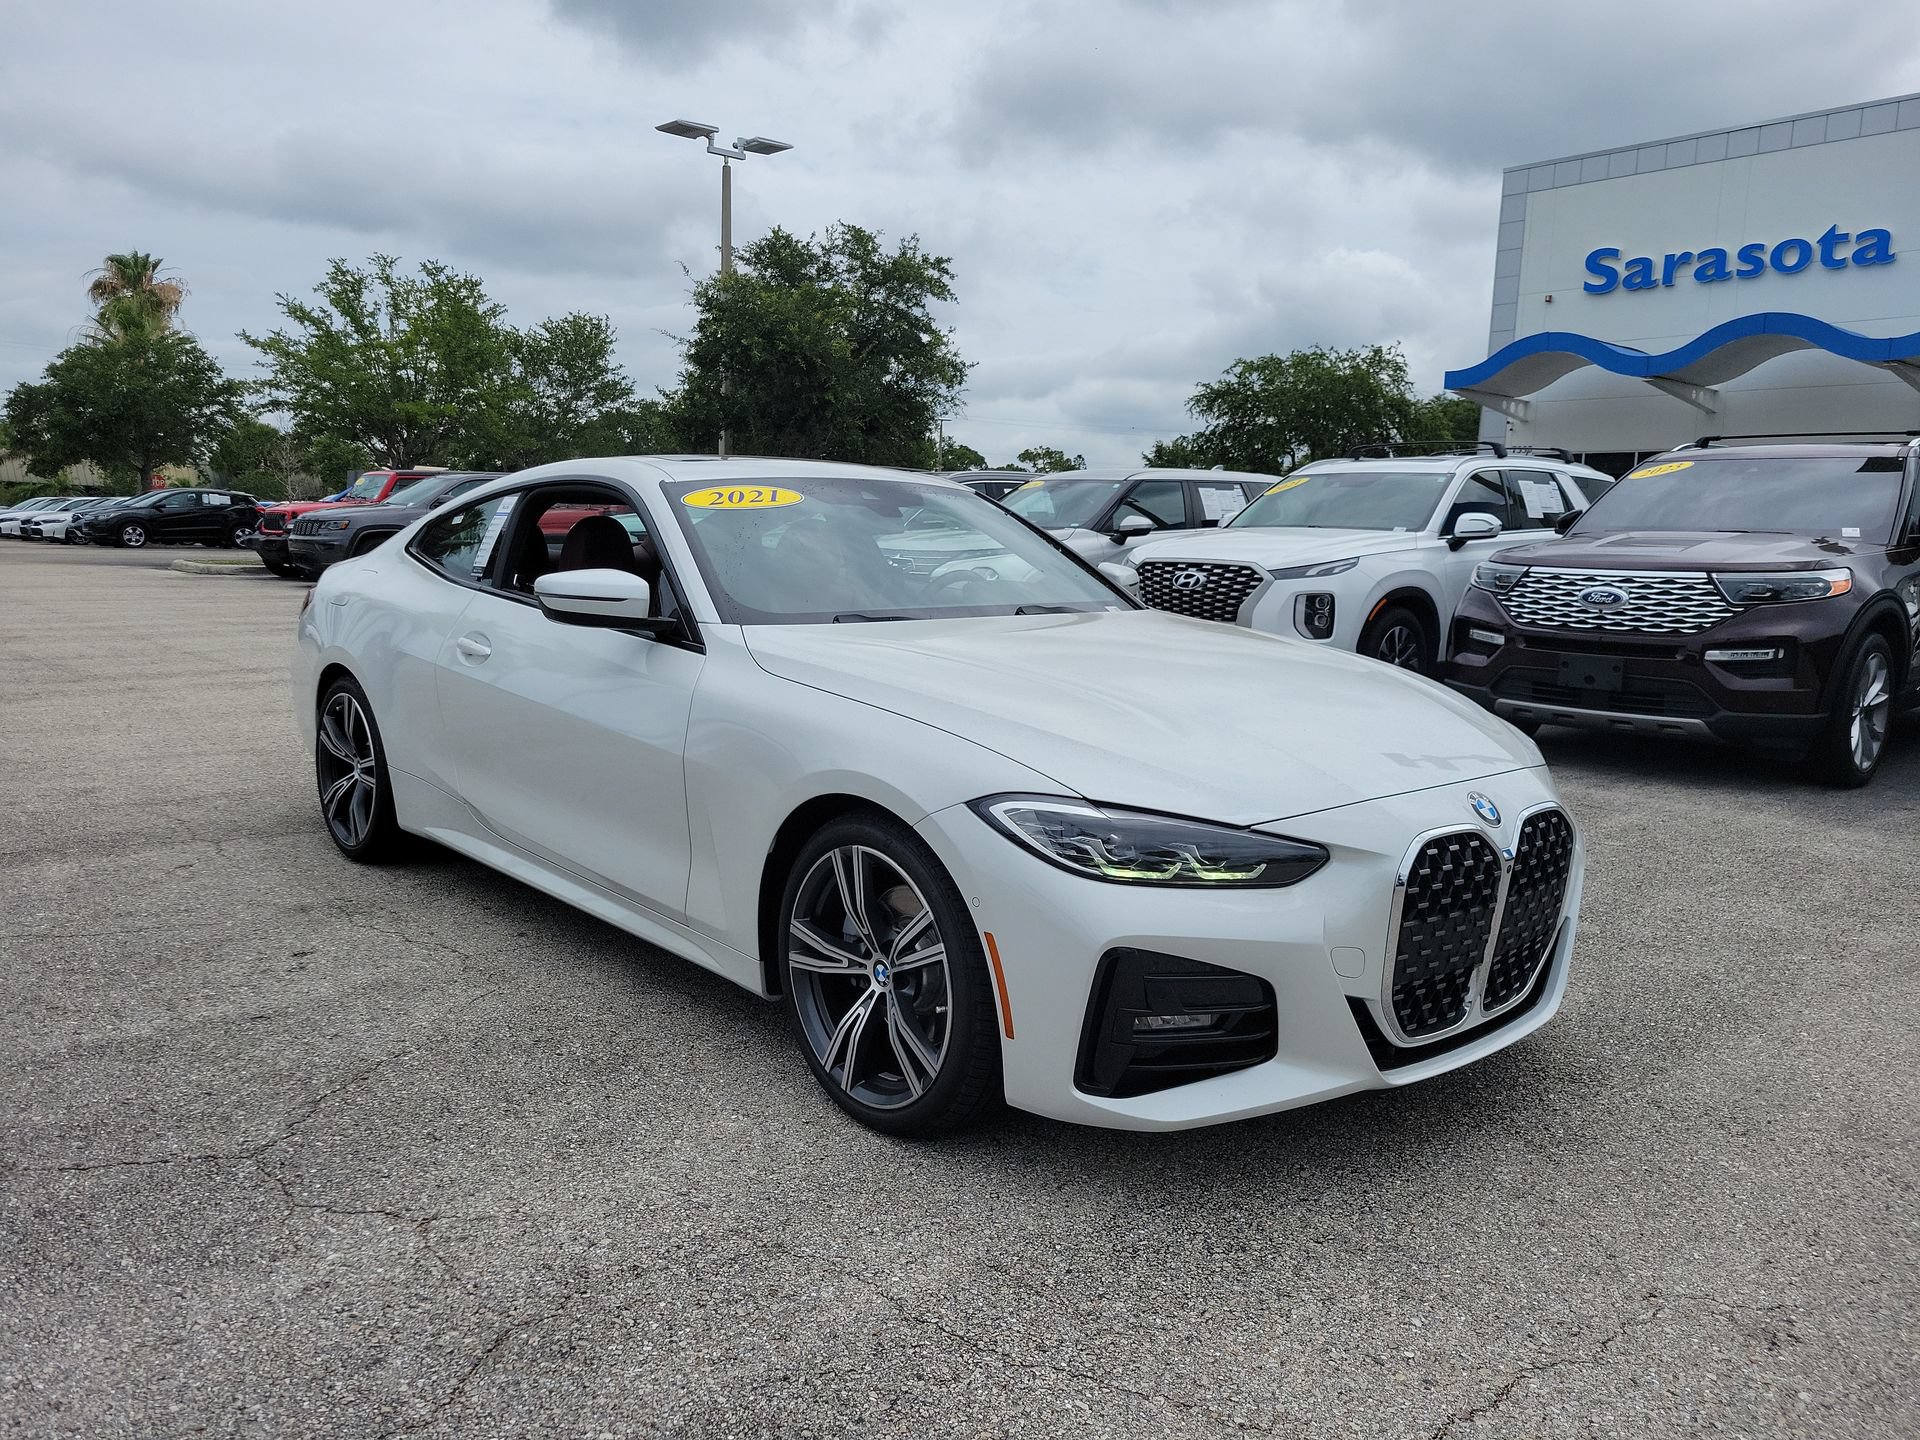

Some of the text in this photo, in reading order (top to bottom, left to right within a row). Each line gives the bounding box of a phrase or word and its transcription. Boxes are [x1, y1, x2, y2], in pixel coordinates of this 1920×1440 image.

[1583, 223, 1897, 294] Sarasota
[708, 489, 780, 506] 2021
[1587, 591, 1615, 604] Ford
